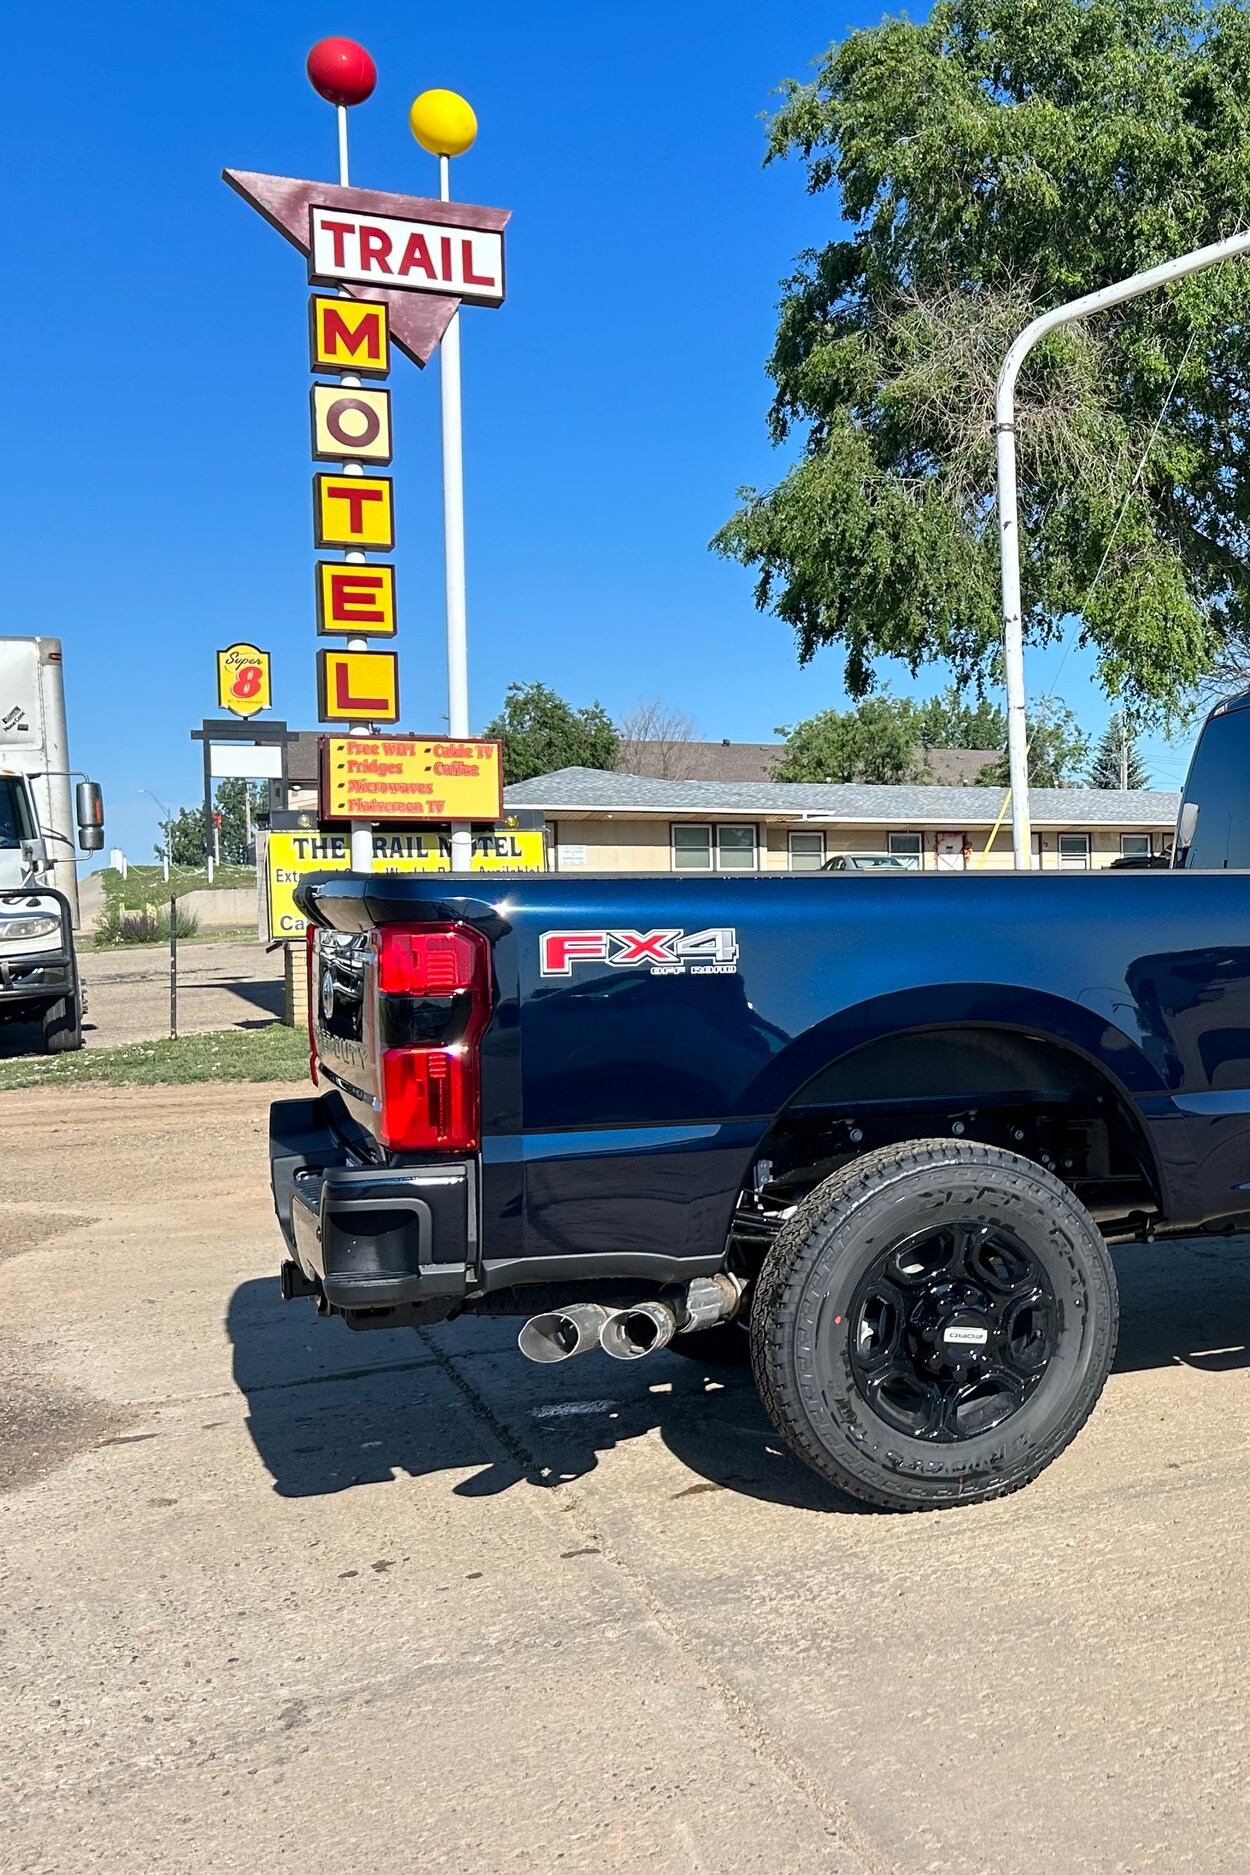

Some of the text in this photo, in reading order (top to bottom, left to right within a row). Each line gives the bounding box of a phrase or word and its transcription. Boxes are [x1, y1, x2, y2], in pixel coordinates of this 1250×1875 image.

[320, 219, 496, 287] TRAIL
[322, 307, 390, 711] MOTEL
[224, 651, 263, 671] Super
[231, 666, 263, 699] 8
[347, 741, 379, 755] Free
[433, 743, 494, 759] Cable TV
[347, 758, 403, 776] Fridges
[433, 761, 480, 776] Coffee
[347, 779, 434, 794] Microwaves
[347, 798, 446, 814] Flatscreen TV
[292, 836, 523, 859] THE RAIL MTEL
[539, 928, 740, 977] FX4
[650, 965, 737, 975] OFF ROAD
